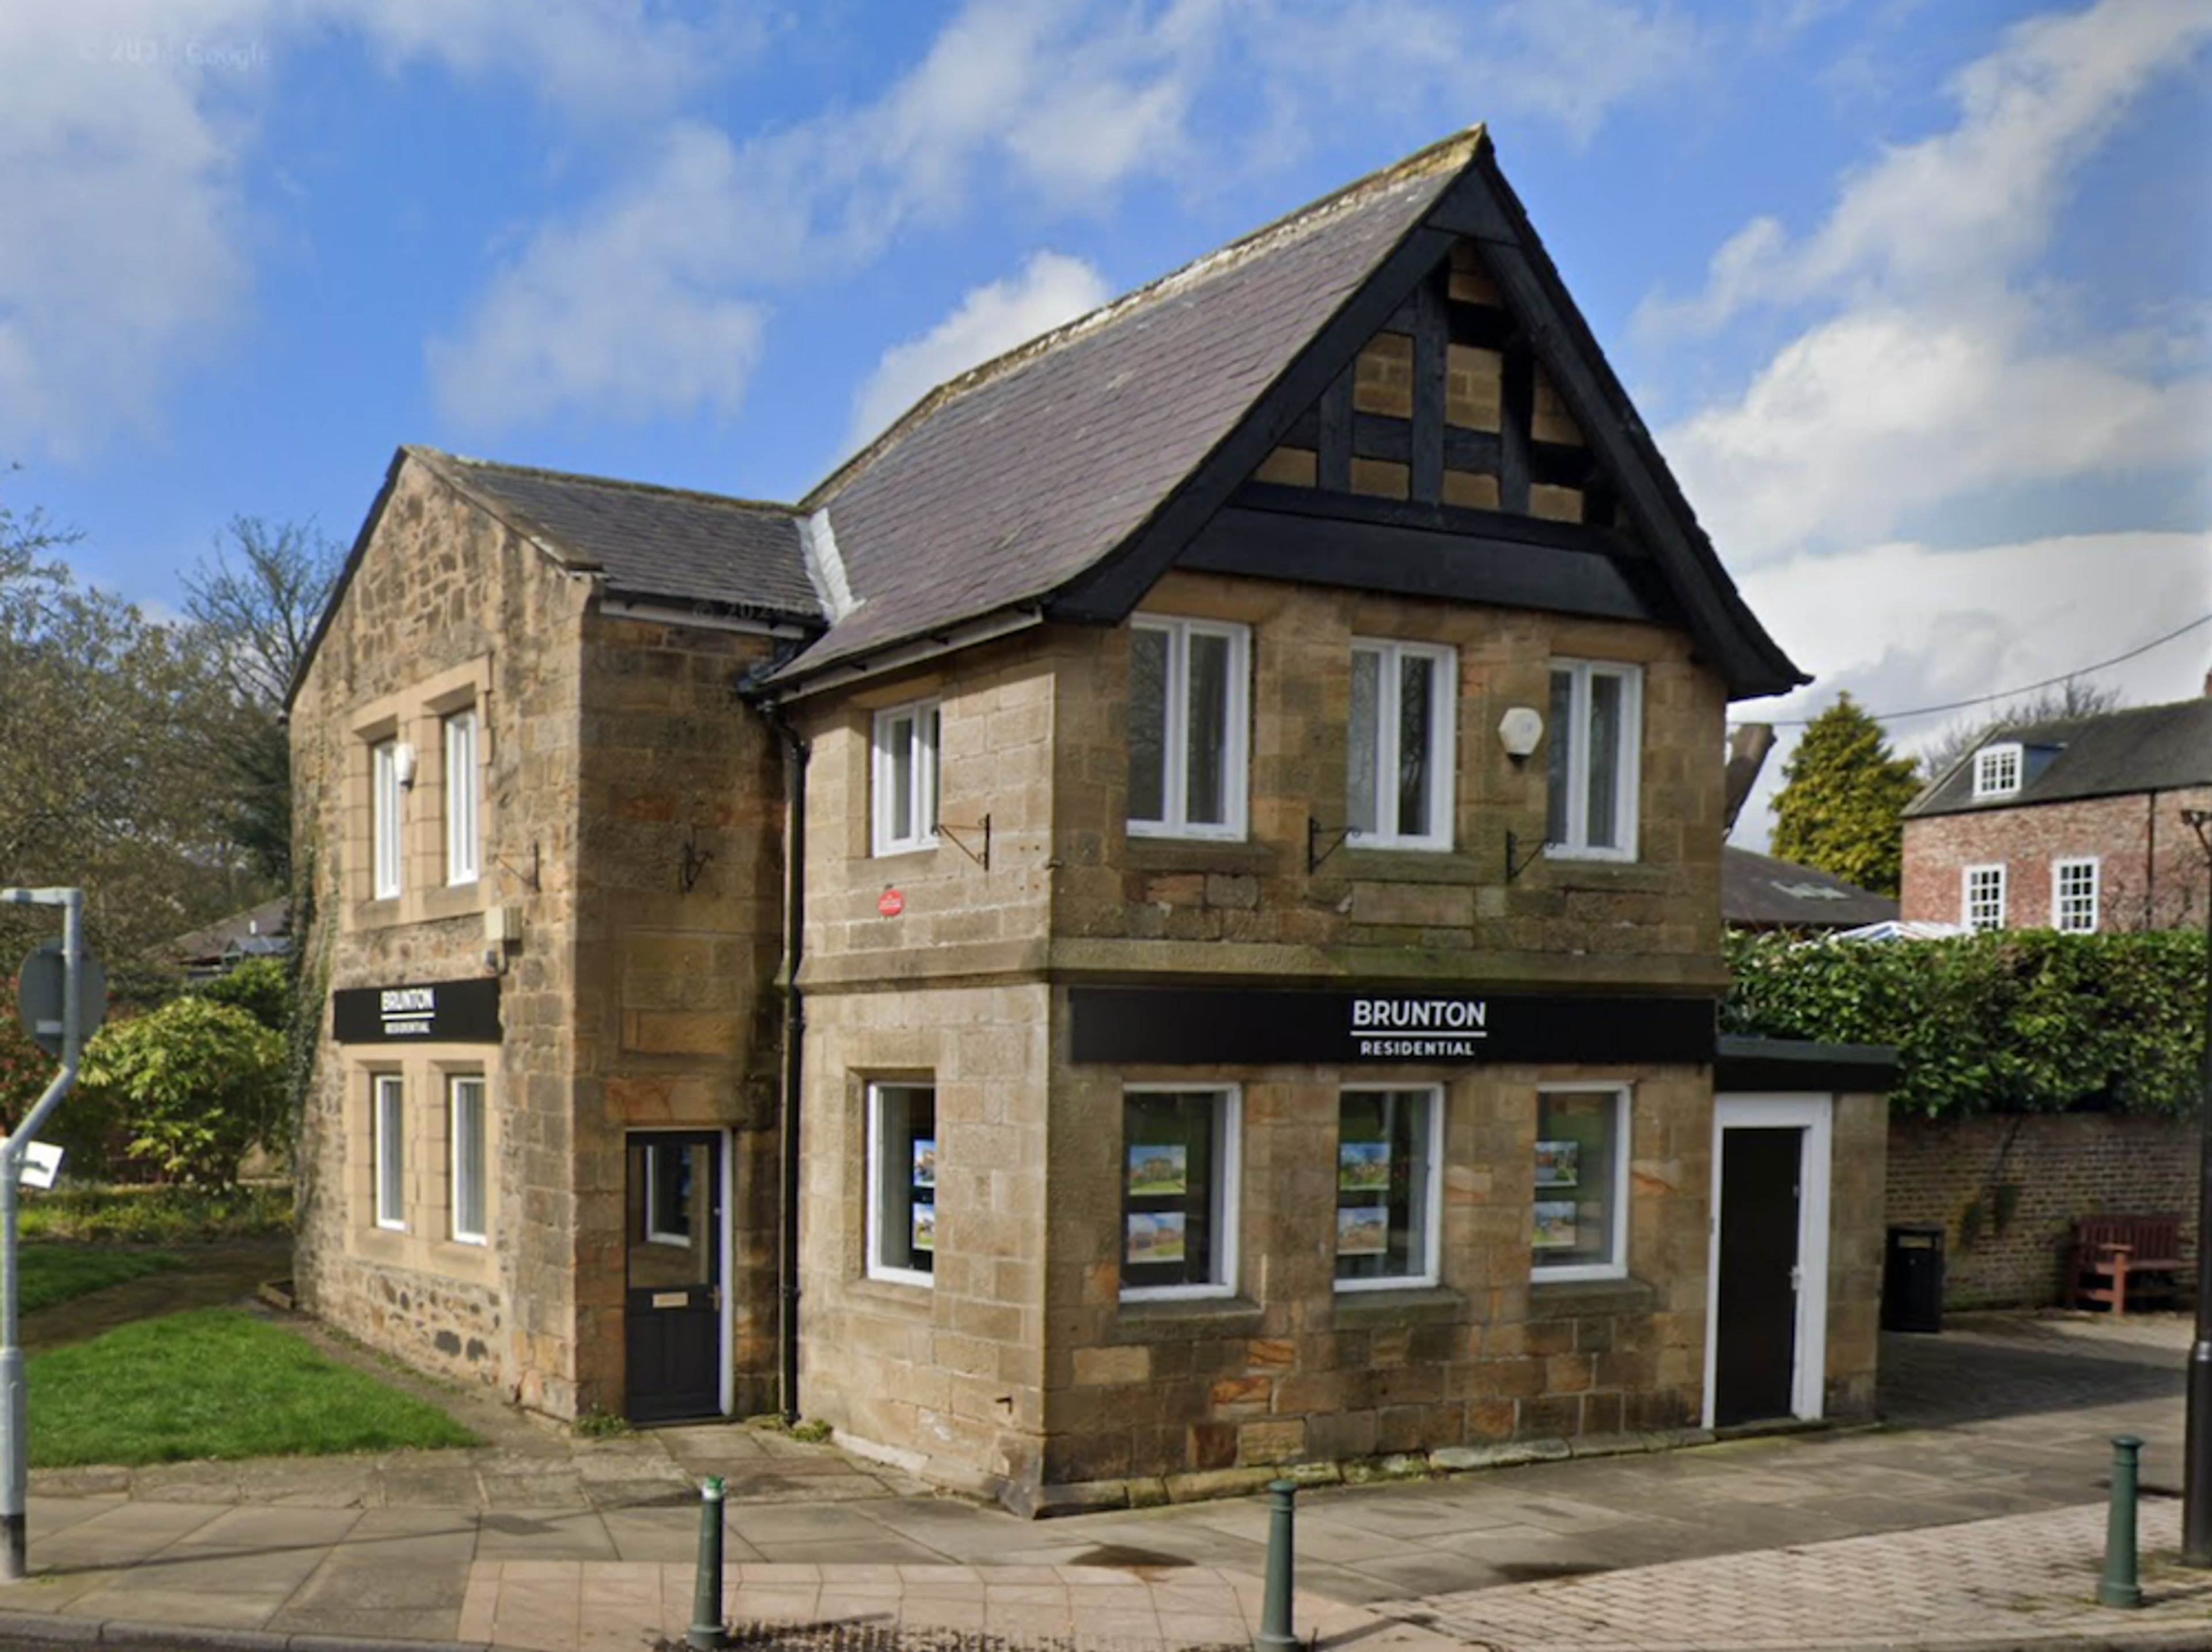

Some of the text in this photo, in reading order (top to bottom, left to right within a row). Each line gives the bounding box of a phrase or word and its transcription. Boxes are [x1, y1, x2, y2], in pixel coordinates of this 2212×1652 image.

[381, 987, 434, 1011] BRUNTON
[1353, 999, 1486, 1027] BRUNTON
[1360, 1040, 1475, 1056] RESIDENTIAL
